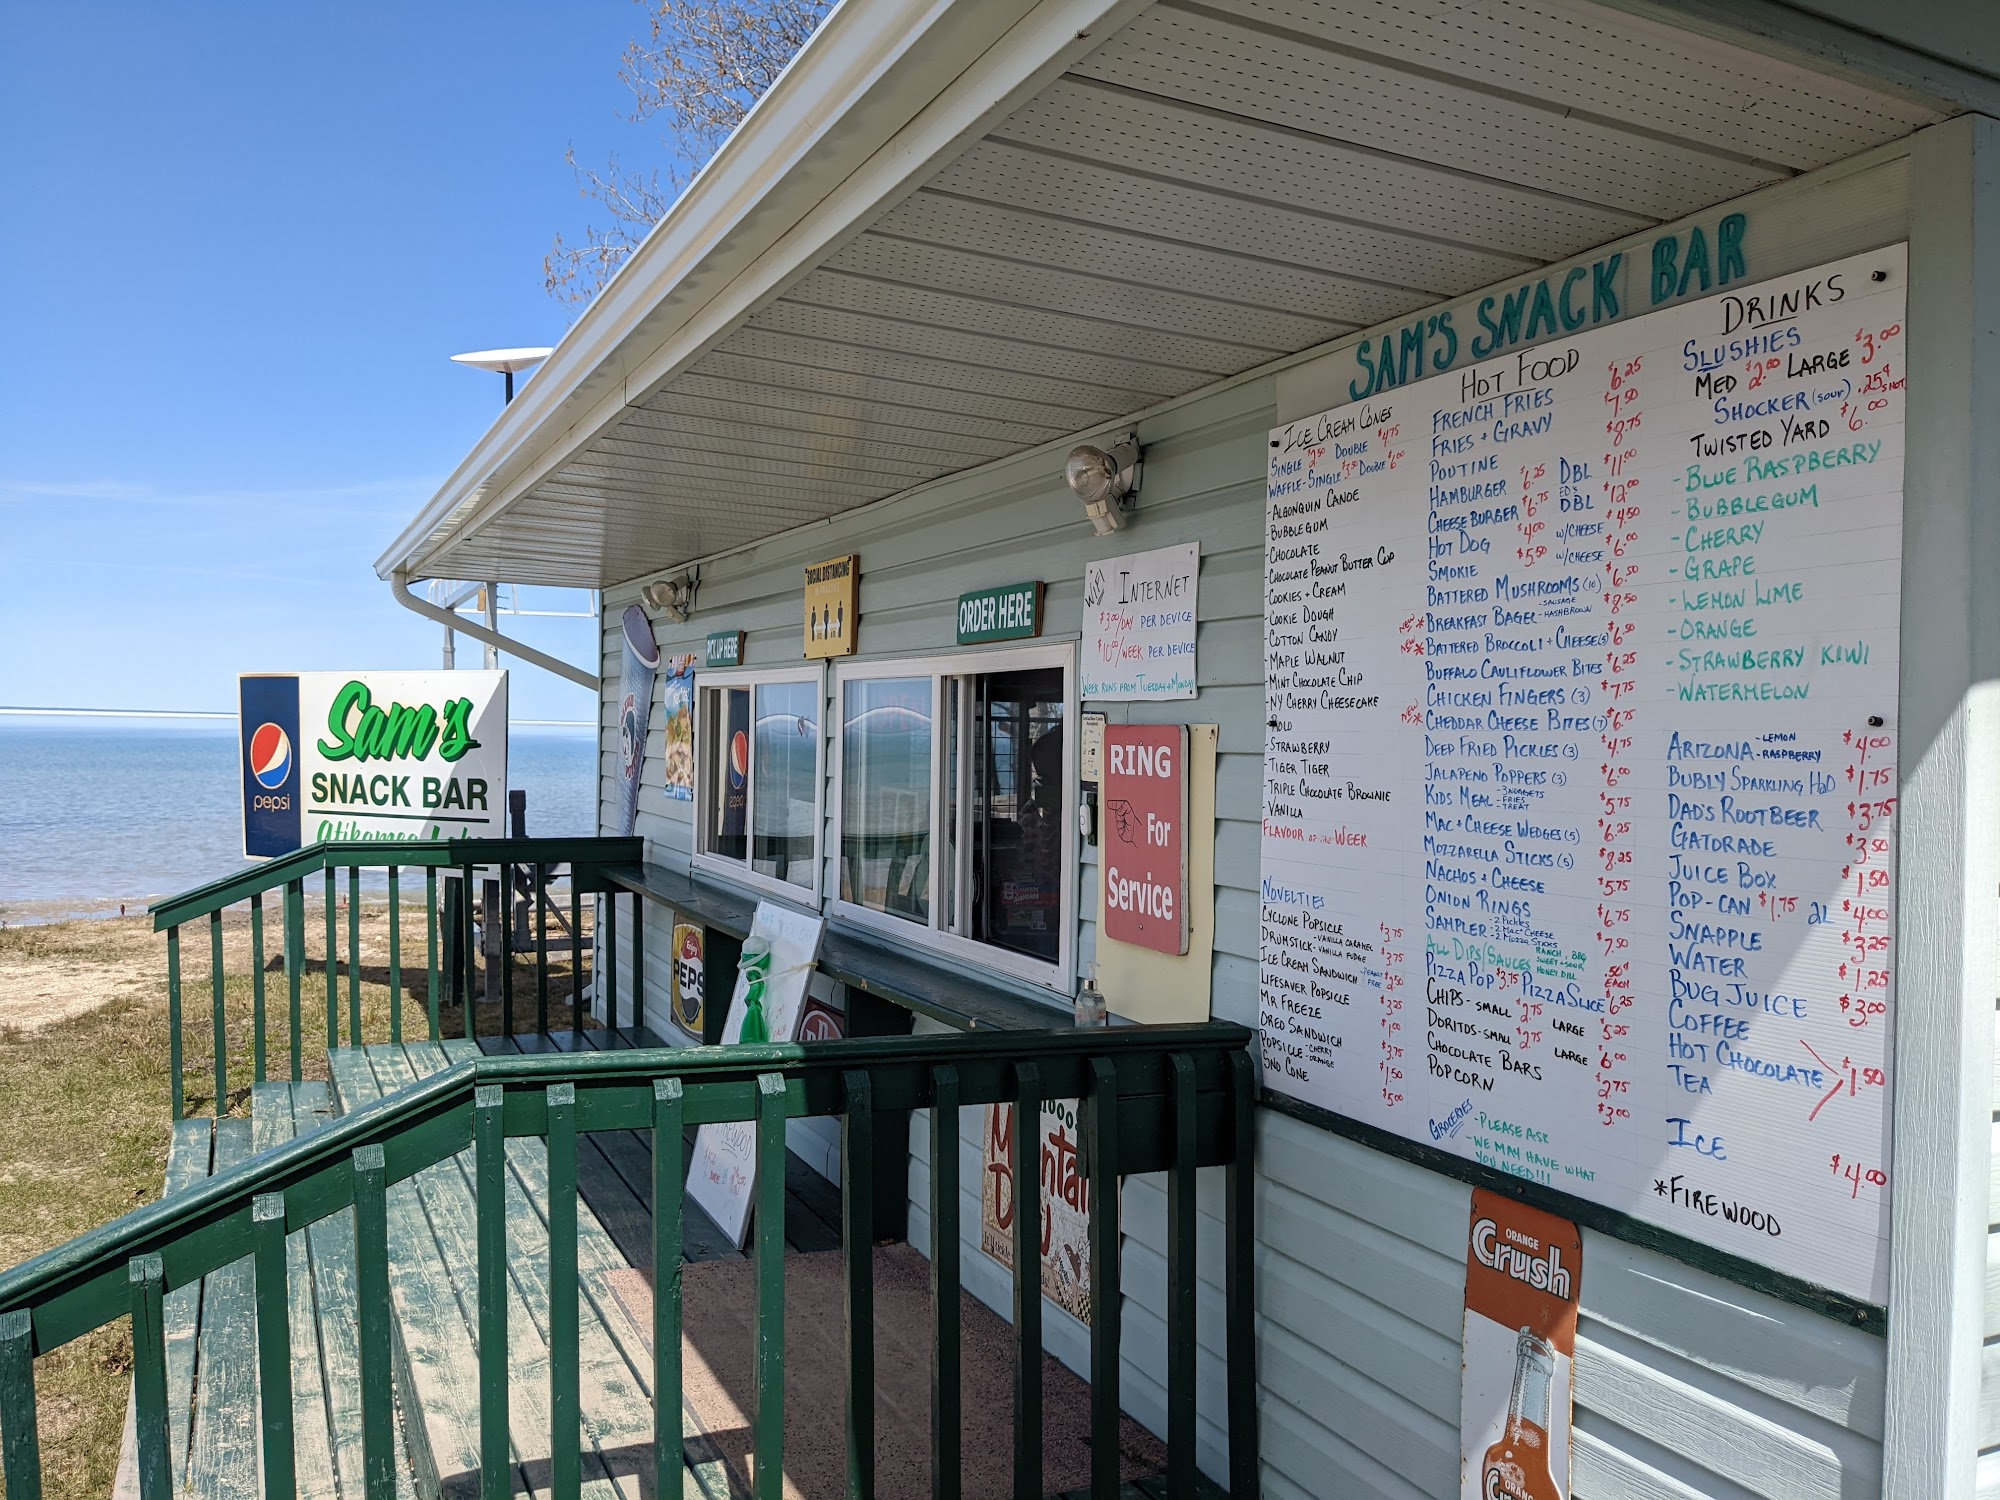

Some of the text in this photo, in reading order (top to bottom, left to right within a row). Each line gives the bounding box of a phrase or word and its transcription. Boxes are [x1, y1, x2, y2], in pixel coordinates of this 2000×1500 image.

[1349, 213, 1747, 401] SAM'S SNACK BAR
[1720, 274, 1845, 335] DRINKS
[1683, 327, 1801, 373] SLUSHIES
[1461, 348, 1579, 403] HOT FOOD
[1696, 373, 1737, 400] MED
[1788, 349, 1850, 378] LARGE
[1433, 403, 1493, 434] FRENCH
[1504, 388, 1553, 418] FRIES
[1714, 392, 1810, 424] SHOCKER
[1284, 404, 1392, 452] ICE CREAM CONES
[1433, 412, 1552, 457] FRIES GRAVY
[1689, 430, 1772, 457] TWISTED
[1780, 414, 1829, 447] YARD
[1271, 441, 1368, 476] SINGLE DOUBLE
[1429, 455, 1498, 482] POUTINE
[1743, 440, 1881, 482] RASPBERRY
[1327, 488, 1359, 507] CANOE
[1430, 457, 1592, 510] HAMBURGER DBL
[1560, 495, 1594, 513] DBL
[1340, 546, 1394, 571] BUTTER CUP
[1429, 530, 1490, 559] HOT DOG
[806, 561, 850, 586] SOCIAL DISTANCING
[1429, 559, 1478, 582] SMOKIE
[1118, 572, 1189, 604] INTERNET
[1312, 581, 1346, 599] CREAM
[1427, 574, 1579, 606] BATTERED MUSHROOMS
[1756, 579, 1802, 606] LIME
[960, 590, 1032, 634] ORDER HERE
[1141, 611, 1192, 628] PER DEVICE
[1303, 605, 1334, 623] DOUGH
[1426, 606, 1537, 633] BREAKFAST BAGEL
[724, 636, 738, 658] HERE
[1148, 642, 1195, 658] PER DEVICE
[1304, 649, 1345, 666] WALNUT
[1425, 633, 1542, 656] BATTERED BROCCOLI
[1821, 641, 1869, 665] KIWI
[1425, 657, 1602, 681] BUFFALO CAULIFLOWER BITES
[1427, 682, 1565, 707] CHICKEN FINGERS
[318, 680, 481, 762] Sam's
[1425, 708, 1590, 731] CHEDDAR CHEESE BITES
[1110, 744, 1171, 778] RING
[1425, 734, 1558, 758] DEEP FRIED PICKLES
[1667, 731, 1755, 761] ARIZONA
[1425, 762, 1546, 785] JALAPENO POPPERS
[1666, 765, 1725, 791] BUBLY
[254, 794, 290, 812] pepsi
[312, 772, 488, 811] SNACK BAR
[1346, 780, 1391, 801] BROWNIE
[1425, 784, 1493, 809] KIDS MEAL
[1668, 792, 1715, 821] DAD'S
[1147, 812, 1170, 847] For
[1263, 818, 1304, 841] FLAVOUR
[1335, 826, 1367, 847] WEEK
[1425, 810, 1561, 840] MAC CHEESE WEDGES
[1671, 821, 1777, 857] GATORADE
[1423, 835, 1553, 867] MOZZARELLA STICKS
[1426, 858, 1545, 894] NACHOS CHEESE
[1669, 854, 1728, 884] JUICE
[1737, 861, 1776, 889] BOX
[1108, 866, 1172, 920] Service
[1263, 876, 1325, 909] NOVELTIES
[1425, 884, 1531, 917] ONION RINGS
[1262, 905, 1343, 935] CYCLONE POPSICLE
[1425, 904, 1487, 938] SAMPLER
[1669, 910, 1762, 951] SNAPPLE
[1312, 956, 1357, 984] SANDWICH
[1426, 952, 1494, 989] PIZZA POP
[1668, 942, 1748, 979] WATER
[1261, 968, 1349, 1005] LIFESAVER POPSICLE
[1669, 969, 1718, 1007] BUG
[1725, 983, 1807, 1018] JUICE
[1281, 994, 1322, 1019] FREEZE
[1669, 998, 1750, 1041] COFFEE
[1287, 1017, 1342, 1048] SANDWICH
[1285, 1057, 1309, 1082] CONE
[1427, 1031, 1542, 1080] CHOCOLATE BARS
[1669, 1032, 1824, 1089] HOT CHOCOLATE
[1427, 1053, 1494, 1091] POPCORN
[1667, 1064, 1712, 1094] TEA
[1429, 1099, 1473, 1140] GROCERIES
[1526, 1128, 1549, 1143] ASK
[1666, 1118, 1727, 1160] ICE
[1476, 1152, 1496, 1168] YOU
[1495, 1141, 1595, 1181] MAY HAVE WHAT
[1506, 1228, 1539, 1250] ORANGE
[1472, 1218, 1571, 1300] Crush
